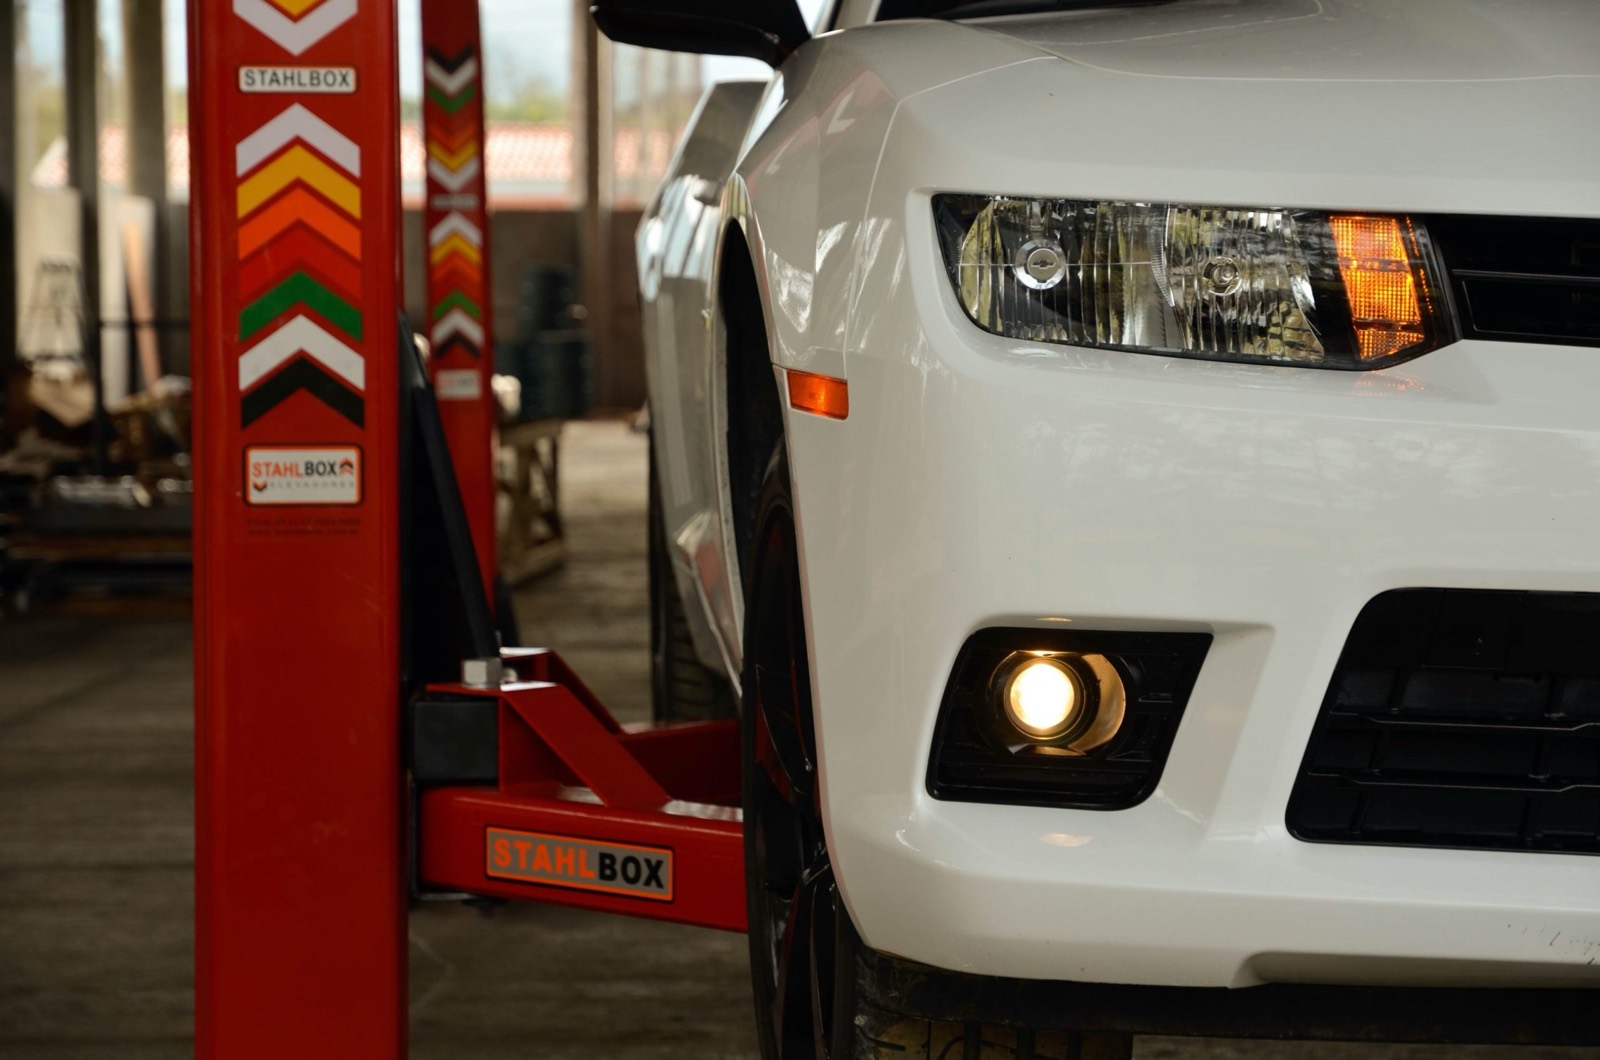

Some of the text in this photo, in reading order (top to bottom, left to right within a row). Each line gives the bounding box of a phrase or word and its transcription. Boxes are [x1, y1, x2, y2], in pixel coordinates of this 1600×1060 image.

[244, 69, 350, 87] STAHLBOX
[253, 460, 337, 478] STAHLBOX
[493, 837, 665, 889] STAHLBOX
